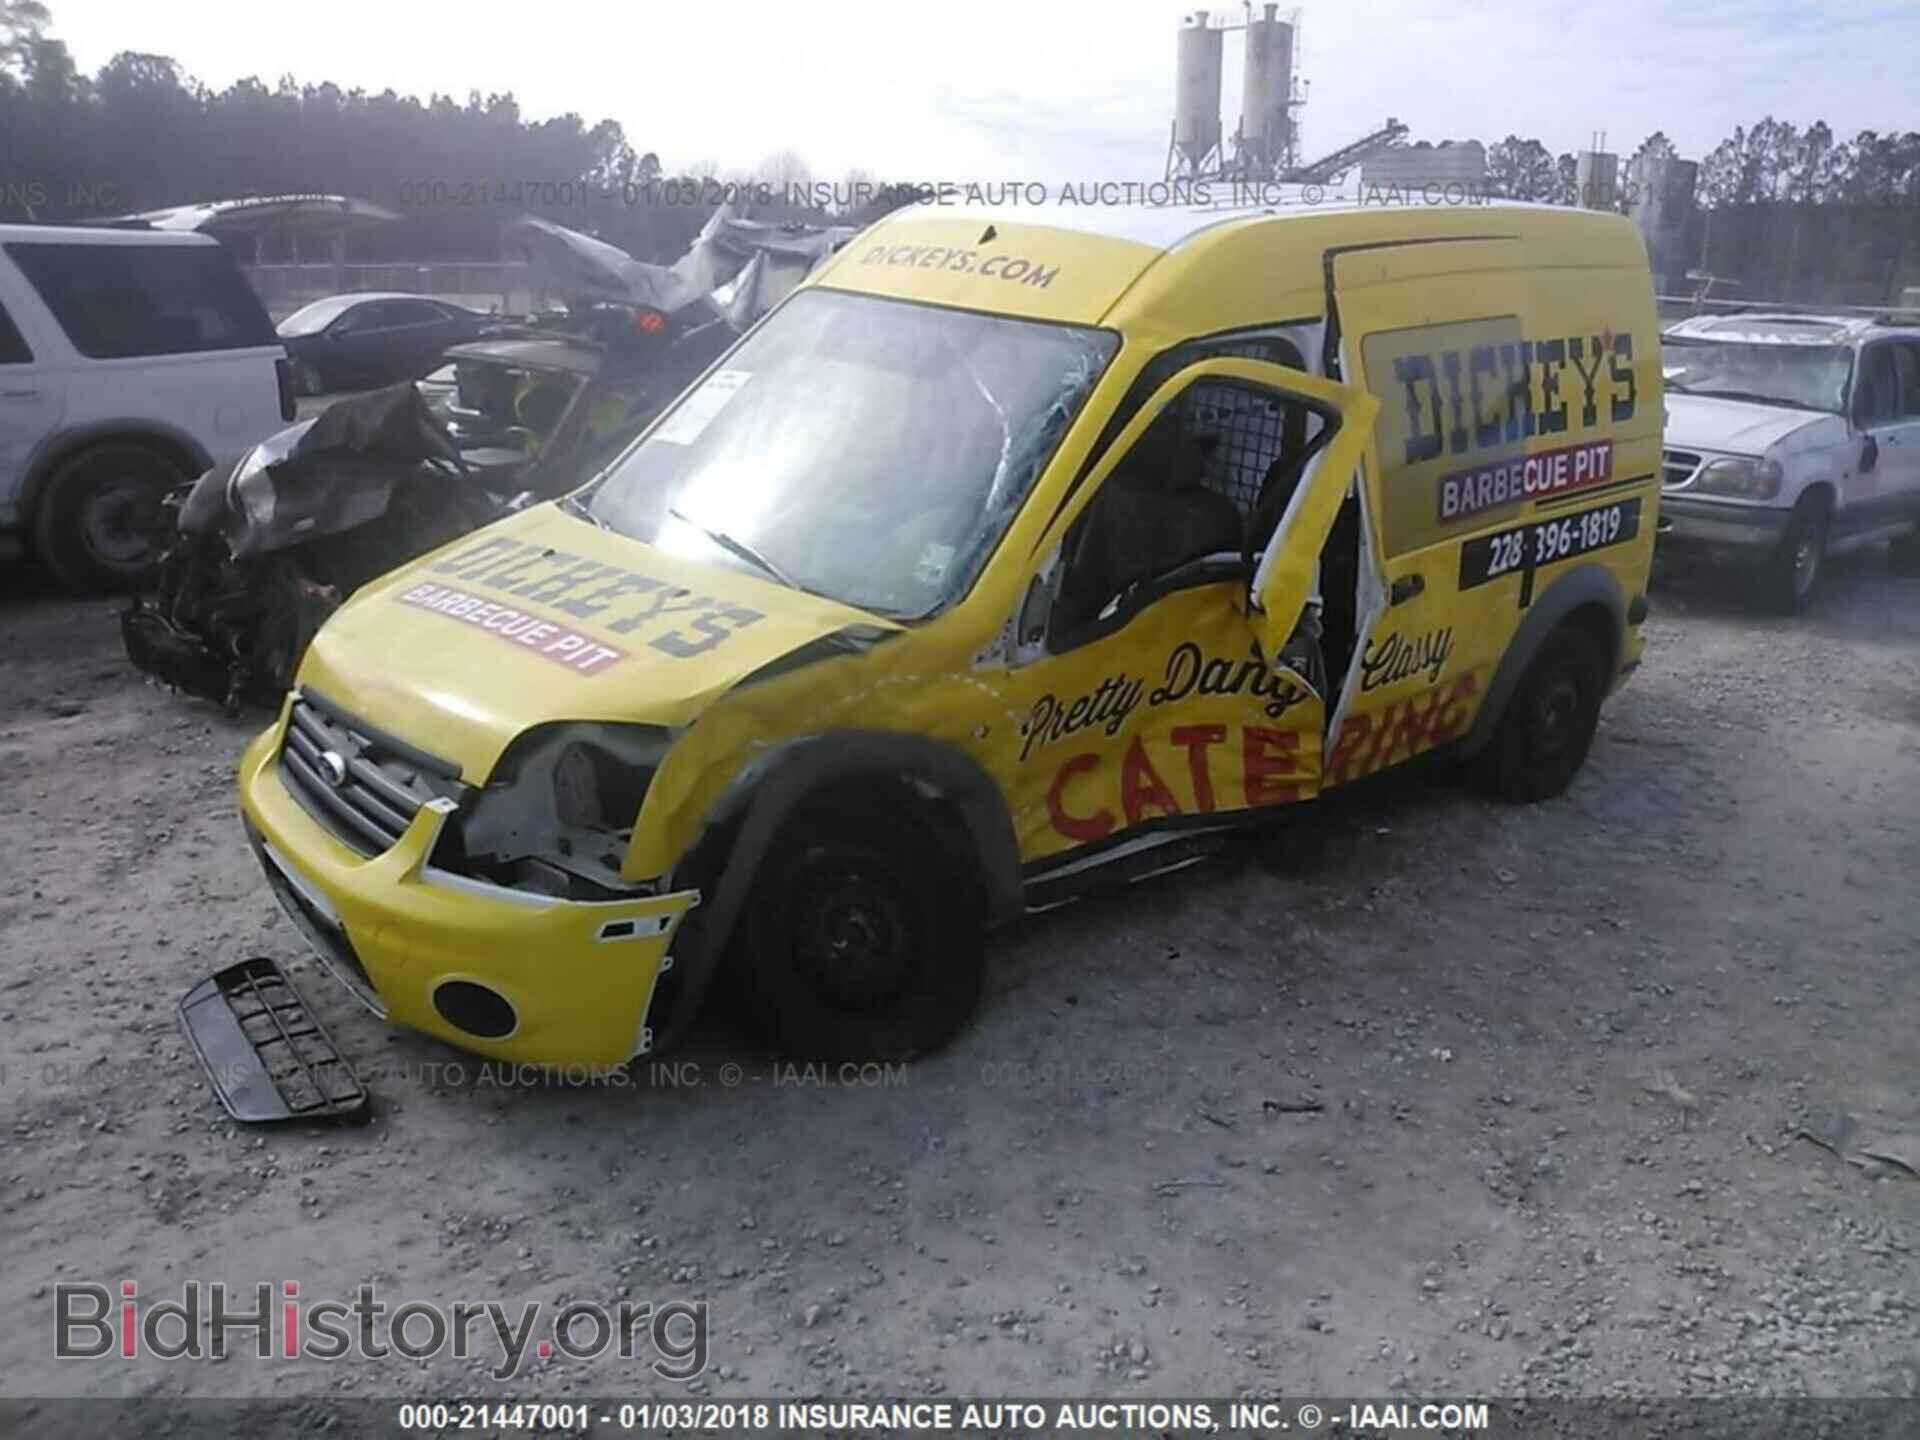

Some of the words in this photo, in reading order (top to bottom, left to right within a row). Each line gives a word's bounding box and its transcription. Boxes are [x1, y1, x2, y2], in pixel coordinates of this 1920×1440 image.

[862, 246, 1060, 288] DICKEYS.COM
[1443, 458, 1567, 517] BARBECUE
[1575, 445, 1609, 482] PIT
[403, 585, 554, 645] BARBECUE
[546, 631, 620, 668] PIT
[1019, 673, 1145, 760] Pretty
[1361, 625, 1453, 692] Classy
